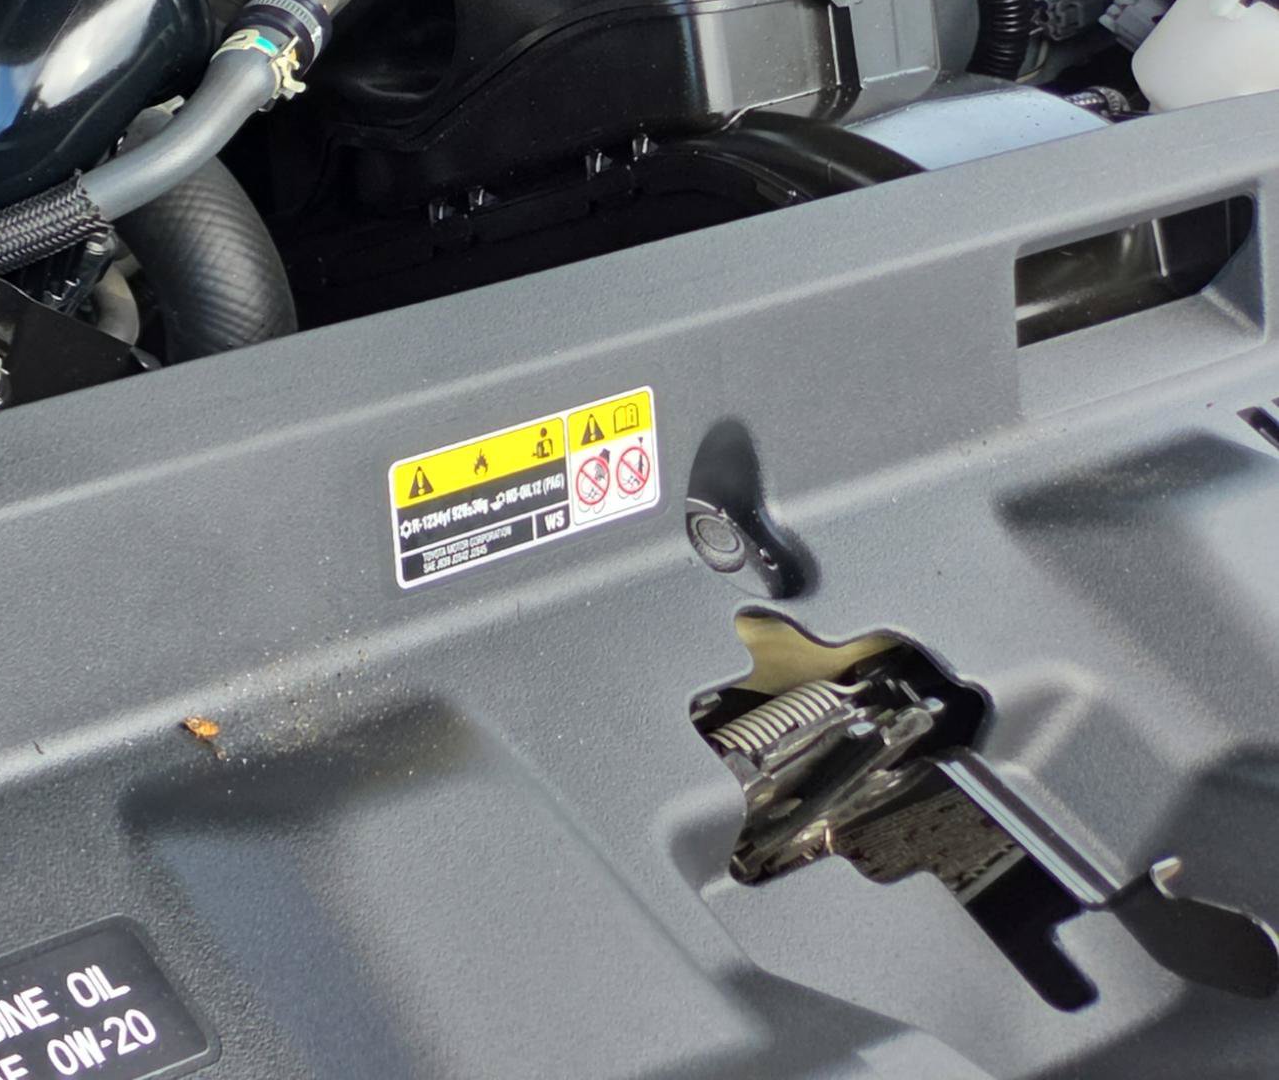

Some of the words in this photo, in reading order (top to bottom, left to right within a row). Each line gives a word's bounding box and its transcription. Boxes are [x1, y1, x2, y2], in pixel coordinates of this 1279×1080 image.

[544, 509, 565, 532] WS
[423, 546, 447, 563] TOYOTA
[446, 538, 469, 555] MOTOR
[469, 524, 513, 548] CORPORATION
[66, 965, 132, 1009] OIL
